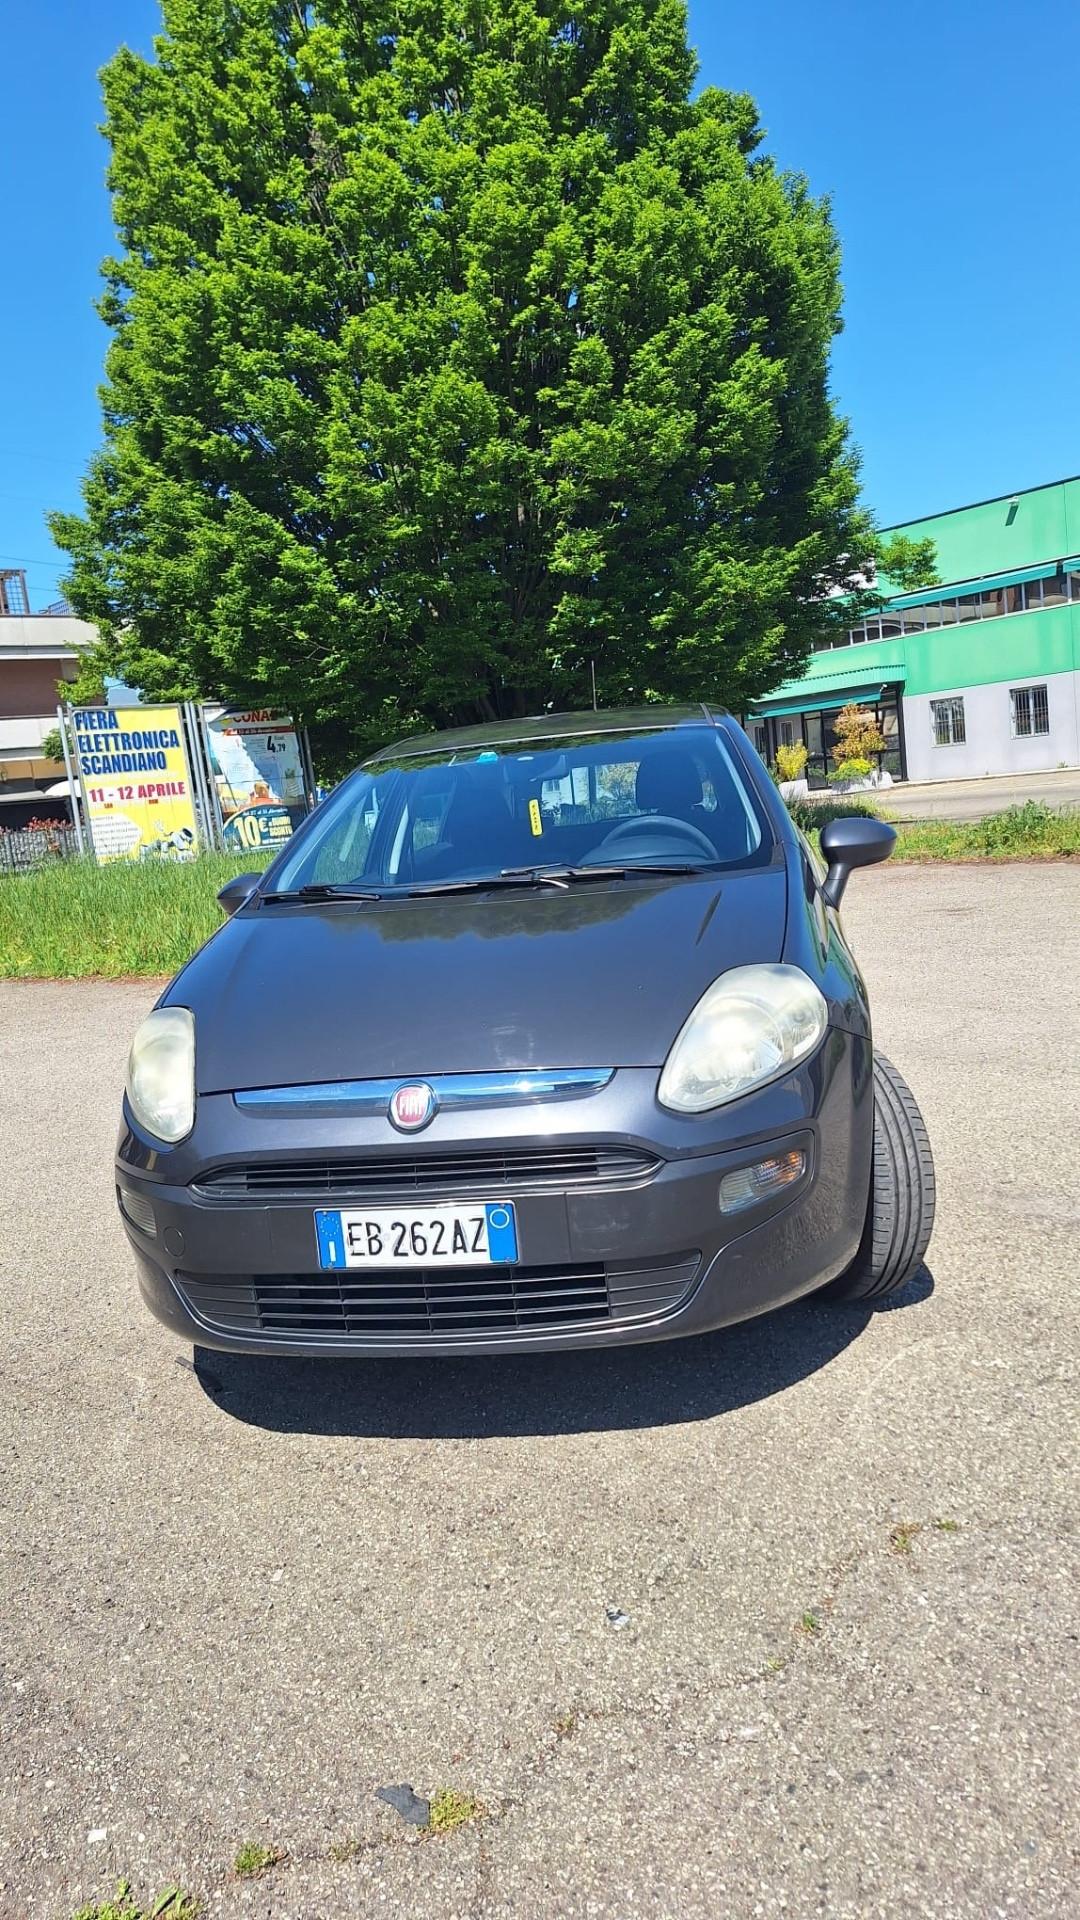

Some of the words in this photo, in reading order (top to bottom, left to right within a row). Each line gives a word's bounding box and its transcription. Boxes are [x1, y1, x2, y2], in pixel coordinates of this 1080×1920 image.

[74, 710, 119, 731] FIERA
[77, 730, 180, 753] ELETTRONICA
[81, 751, 167, 775] SCANDIANO
[89, 788, 104, 802] 11
[117, 786, 134, 800] 12
[138, 782, 186, 798] APRILE
[399, 1094, 425, 1116] FIAT
